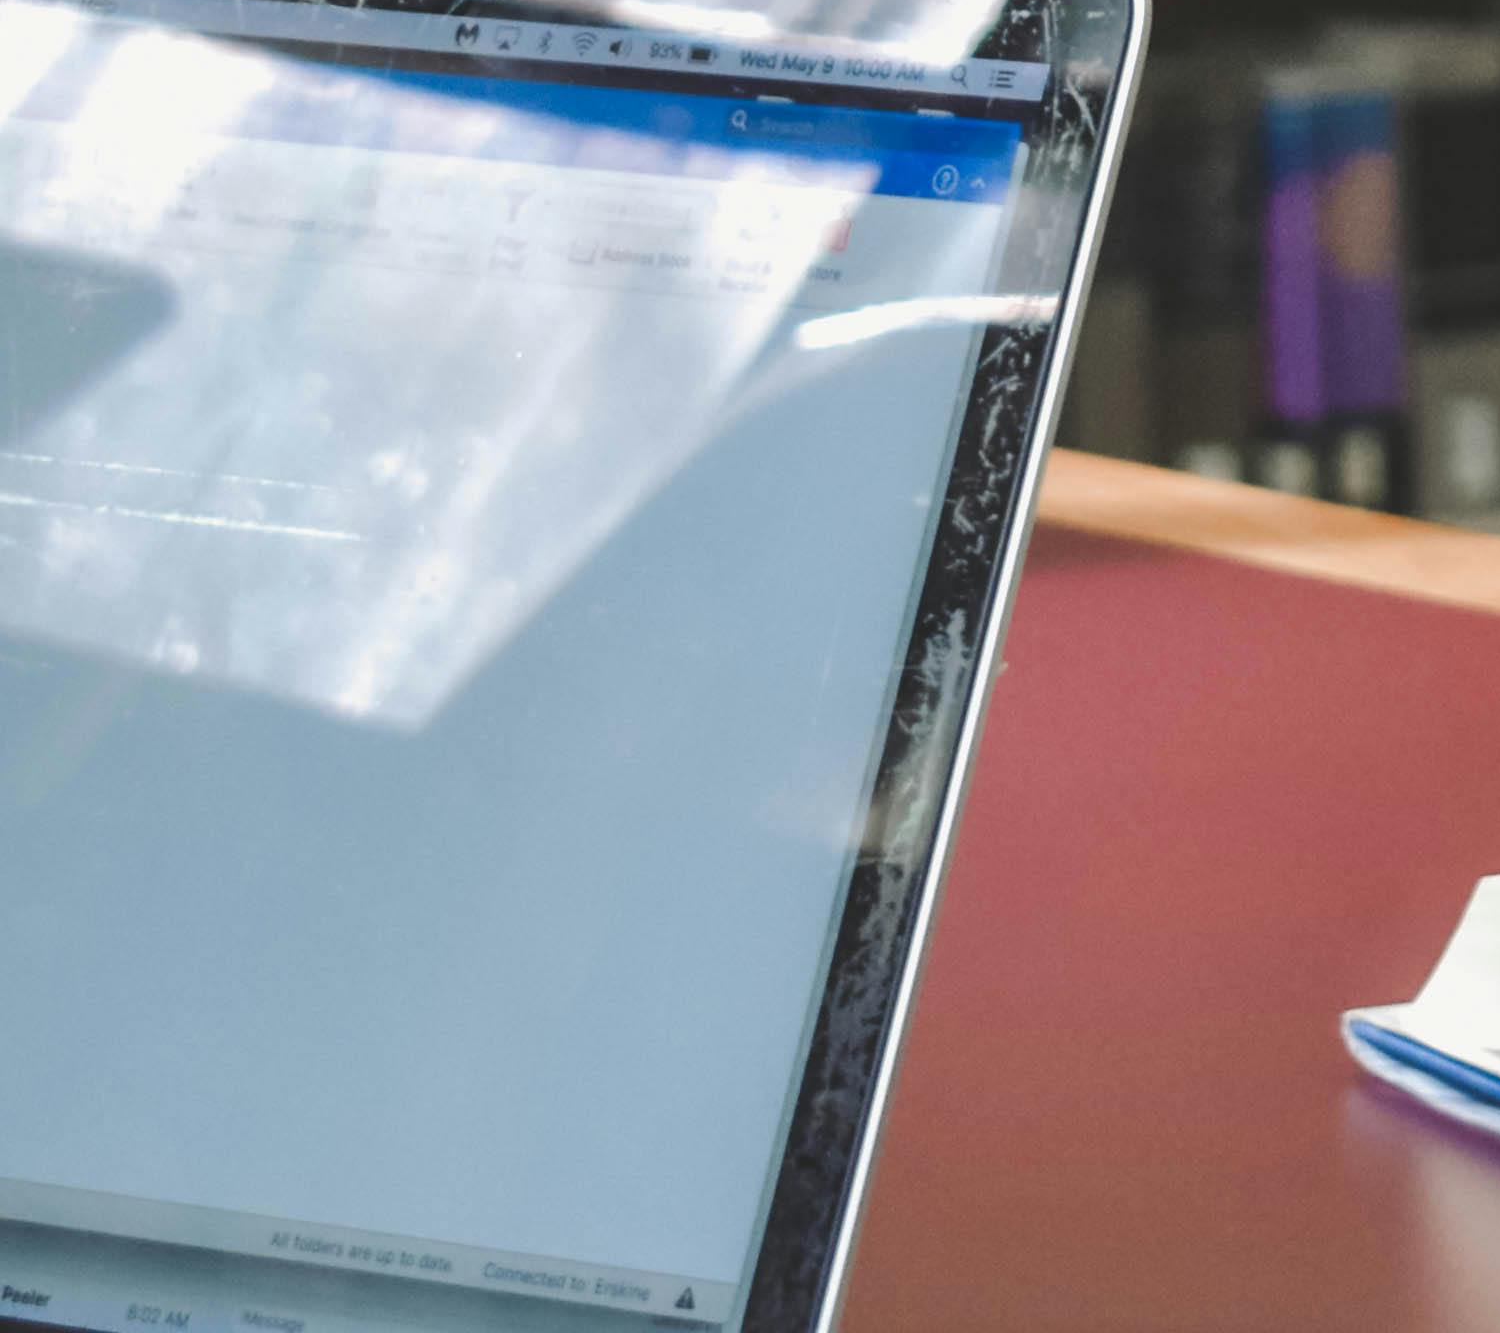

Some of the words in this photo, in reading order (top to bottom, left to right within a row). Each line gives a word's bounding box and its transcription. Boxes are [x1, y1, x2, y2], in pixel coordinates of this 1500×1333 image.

[648, 41, 683, 60] 93%
[739, 50, 777, 72] Wed
[783, 55, 816, 76] May
[822, 56, 835, 74] 9
[895, 64, 926, 83] AM
[348, 1245, 372, 1261] are
[374, 1250, 395, 1265] up
[400, 1251, 416, 1266] to
[418, 1253, 453, 1273] date
[482, 1261, 566, 1290] Connected
